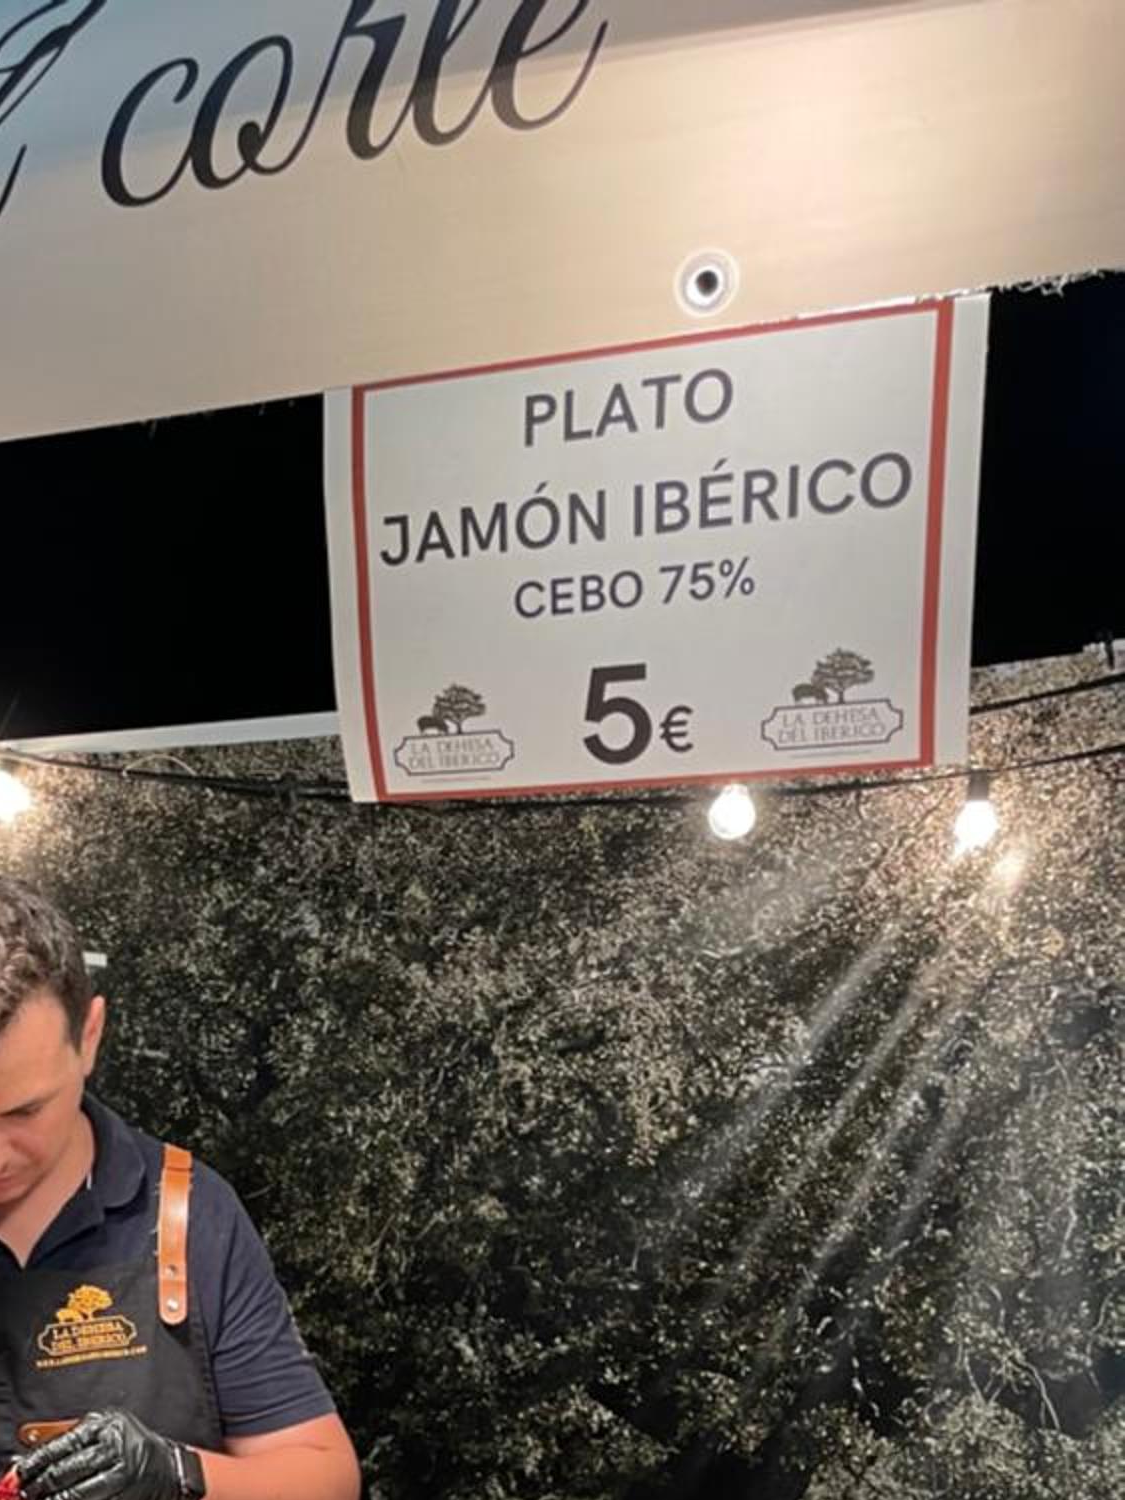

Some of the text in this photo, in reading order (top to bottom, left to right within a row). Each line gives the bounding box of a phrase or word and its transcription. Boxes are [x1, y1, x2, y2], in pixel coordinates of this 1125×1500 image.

[101, 0, 609, 207] corte
[523, 367, 734, 447] PLATO
[380, 451, 912, 566] JAMÓN IBÉRICO
[514, 556, 756, 618] CEBO 75%
[582, 662, 694, 765] 5€
